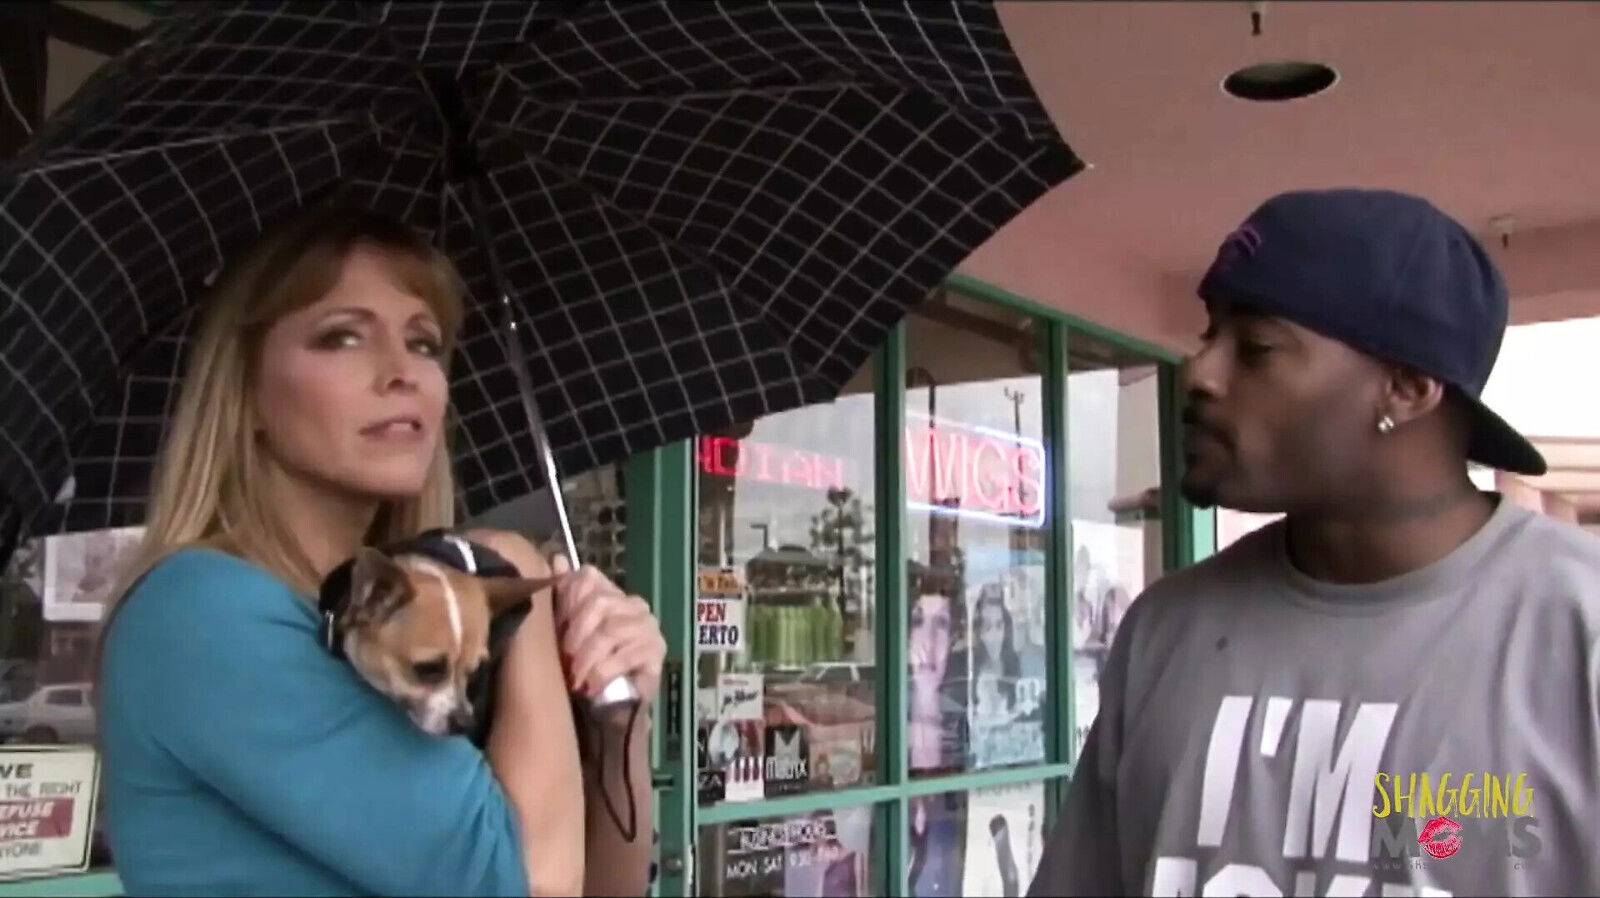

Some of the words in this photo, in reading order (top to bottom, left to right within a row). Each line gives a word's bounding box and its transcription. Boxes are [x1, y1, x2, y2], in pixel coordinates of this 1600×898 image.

[904, 428, 1043, 515] WIGS
[698, 625, 739, 645] ERTO
[1197, 695, 1399, 862] I'M
